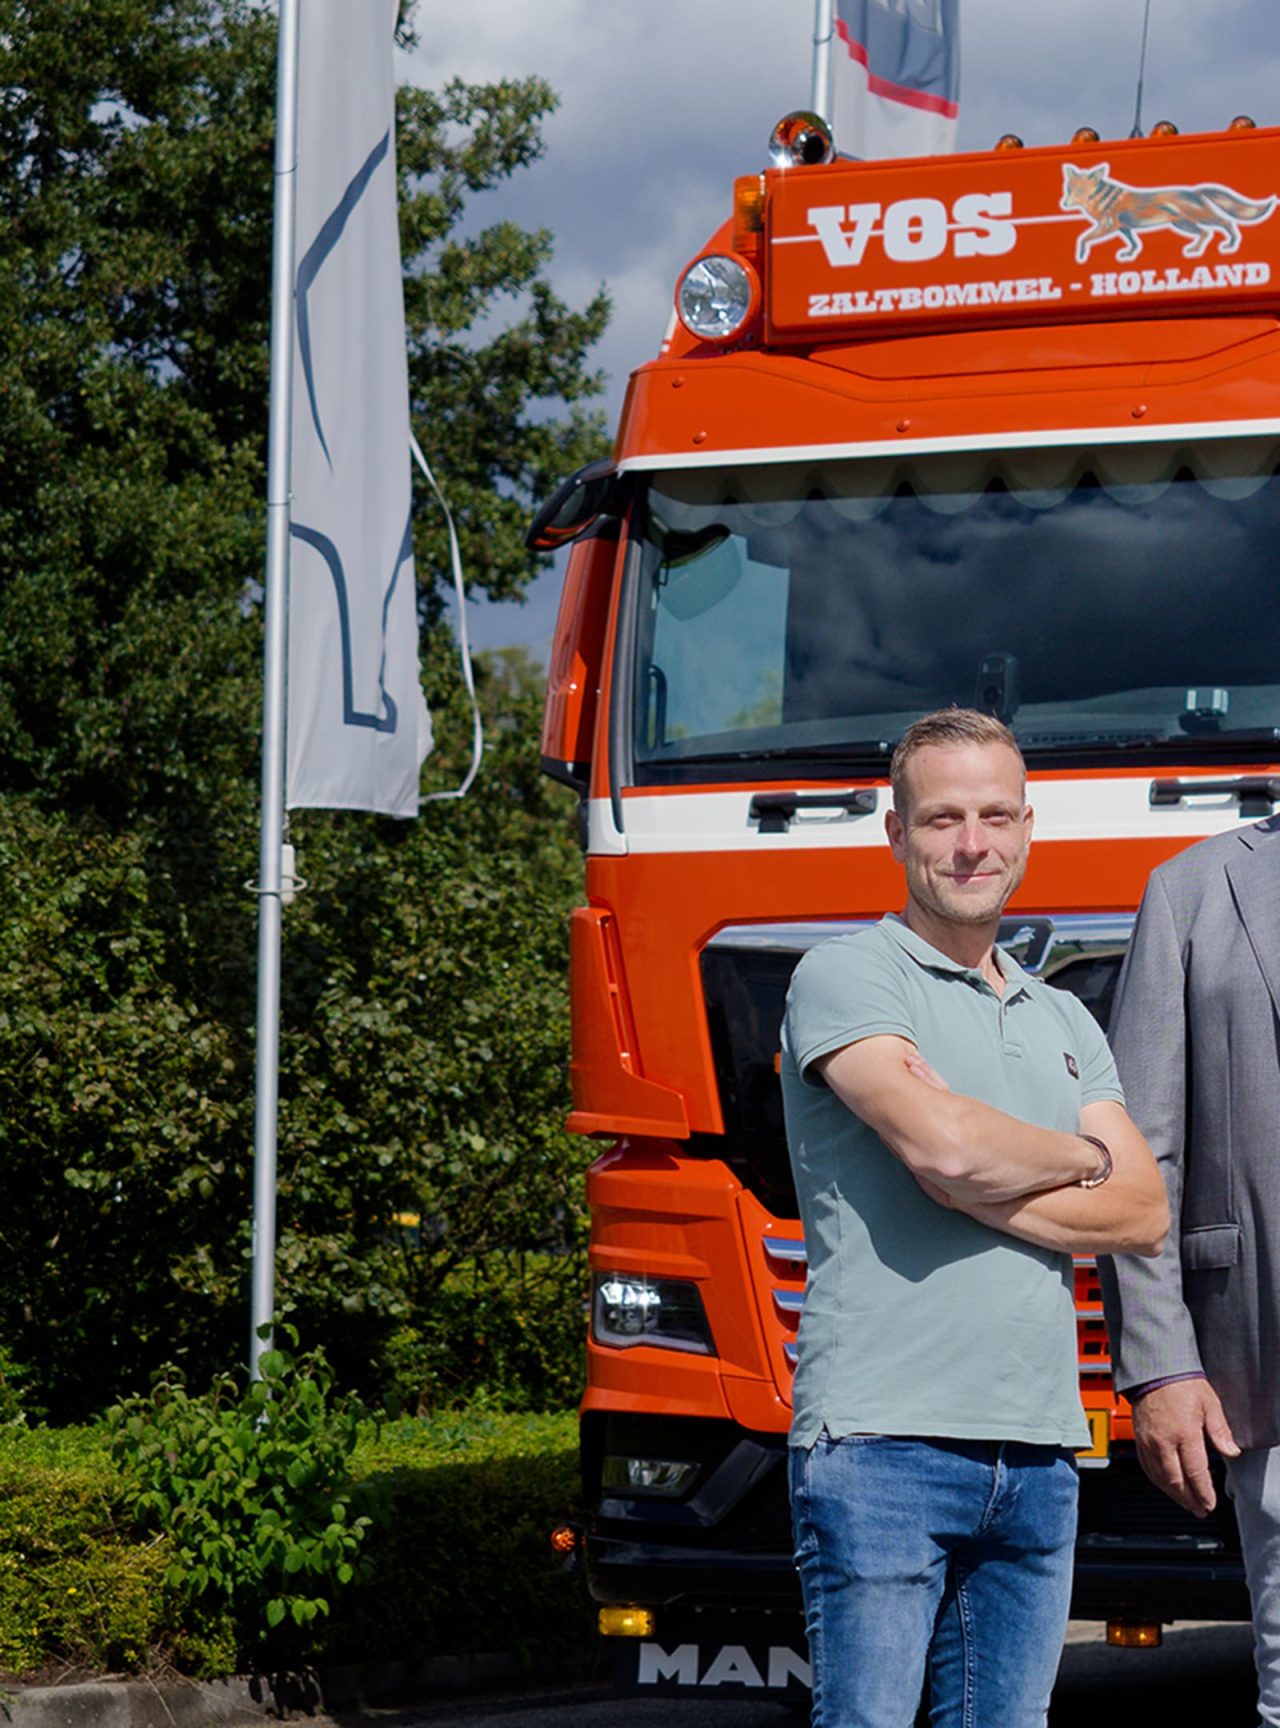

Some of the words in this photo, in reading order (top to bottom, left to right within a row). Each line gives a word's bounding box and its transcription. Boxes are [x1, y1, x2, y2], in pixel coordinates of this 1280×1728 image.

[807, 191, 1018, 268] VOS
[807, 277, 1063, 317] ZALTBOMMEL
[1090, 262, 1271, 297] HOLLAND
[637, 1643, 814, 1688] MAN
